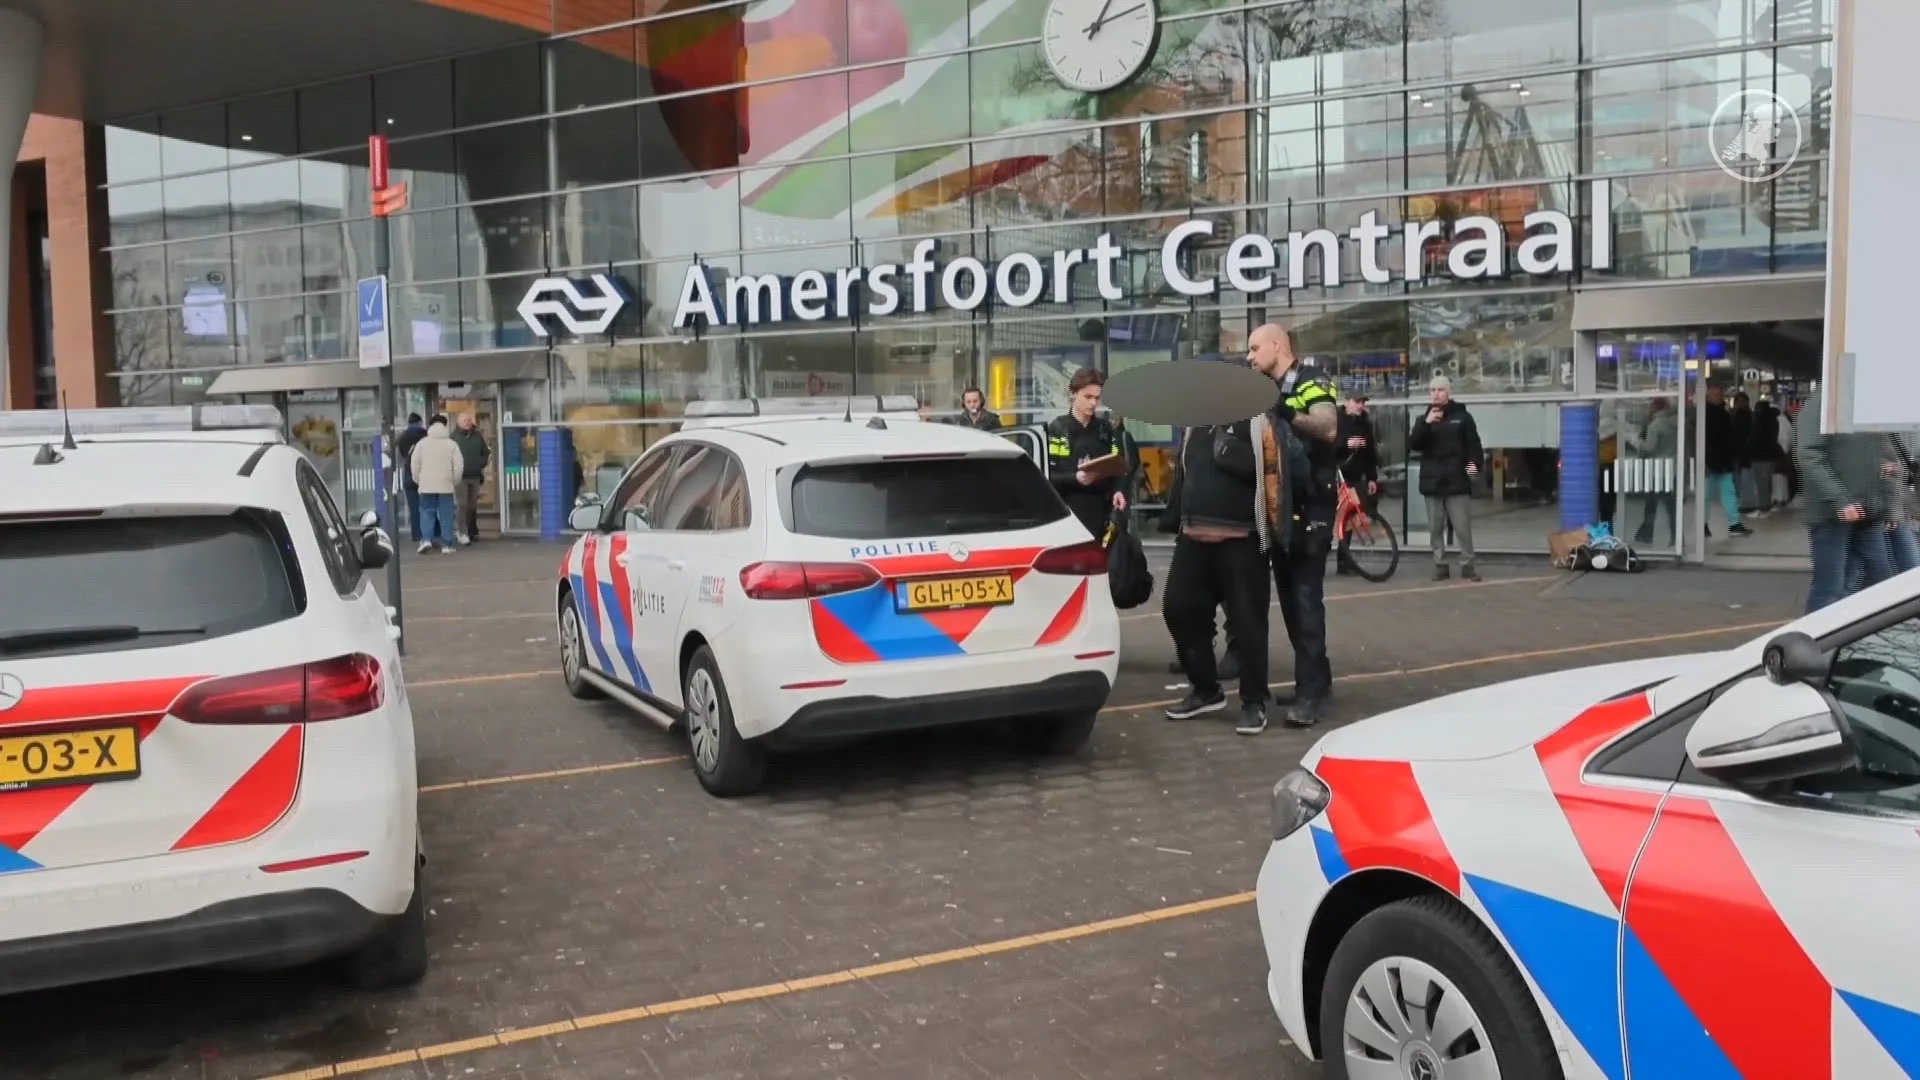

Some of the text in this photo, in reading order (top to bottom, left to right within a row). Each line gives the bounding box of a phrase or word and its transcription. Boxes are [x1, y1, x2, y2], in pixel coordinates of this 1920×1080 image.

[672, 179, 1610, 329] Amersfoort Centraal
[850, 540, 939, 558] POLITIE
[913, 578, 1007, 604] GLH-05-X
[0, 734, 117, 775] -03-X
[0, 781, 28, 790] olitie.nl
